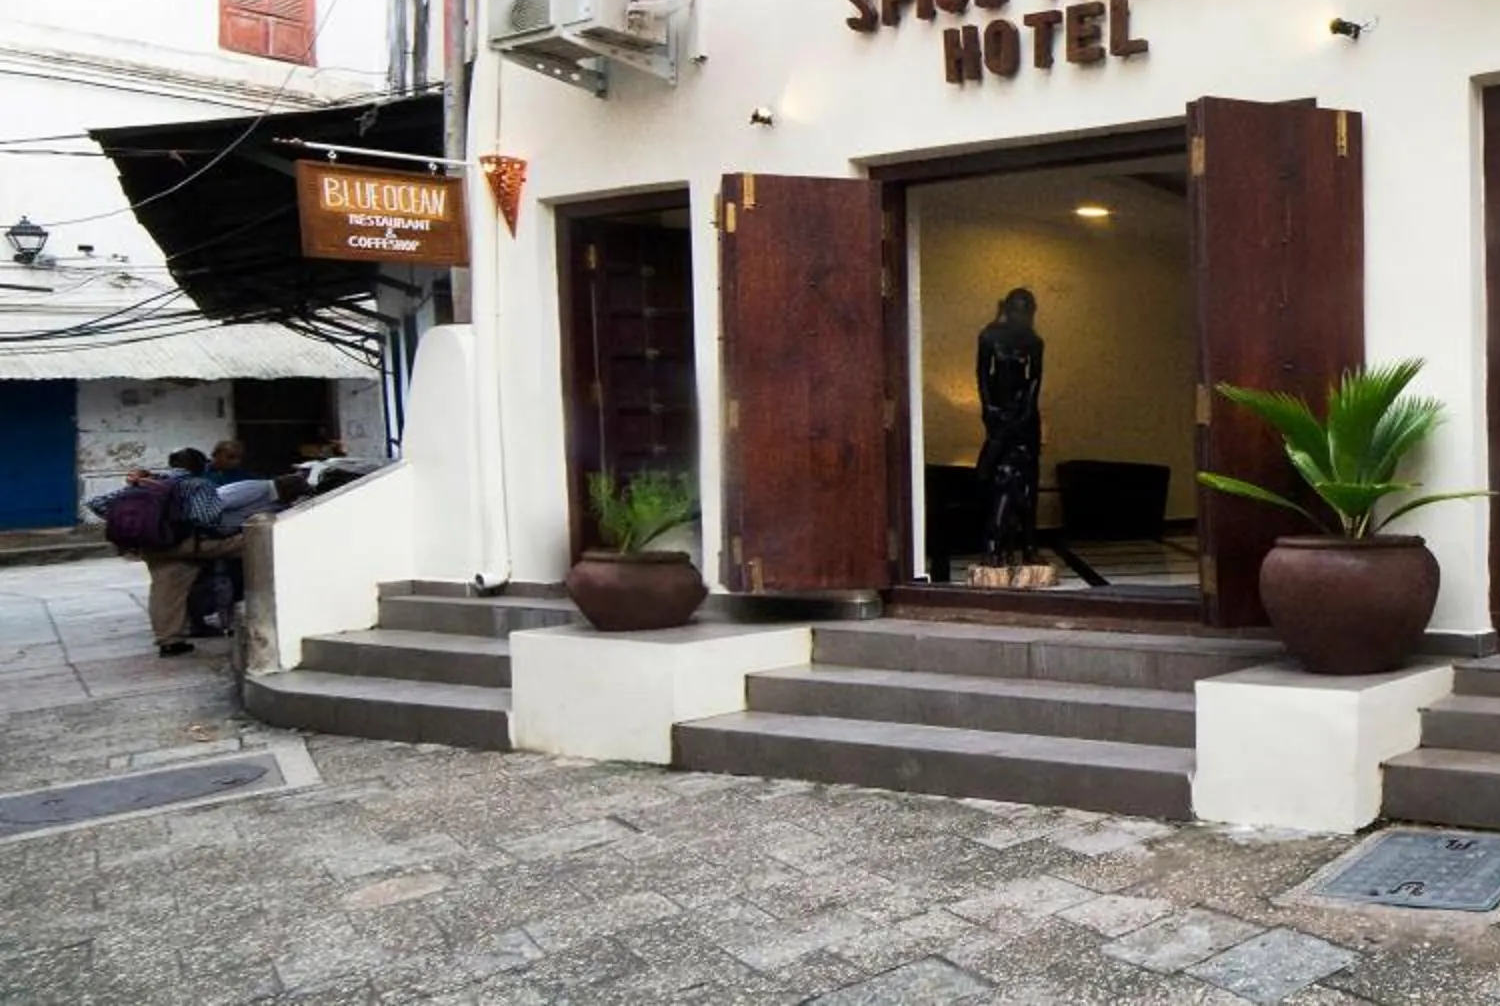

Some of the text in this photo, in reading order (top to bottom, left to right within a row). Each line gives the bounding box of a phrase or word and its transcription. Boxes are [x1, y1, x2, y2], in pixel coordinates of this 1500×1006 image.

[323, 177, 446, 217] BLUE OCEAN
[348, 213, 431, 231] RESTAURANT
